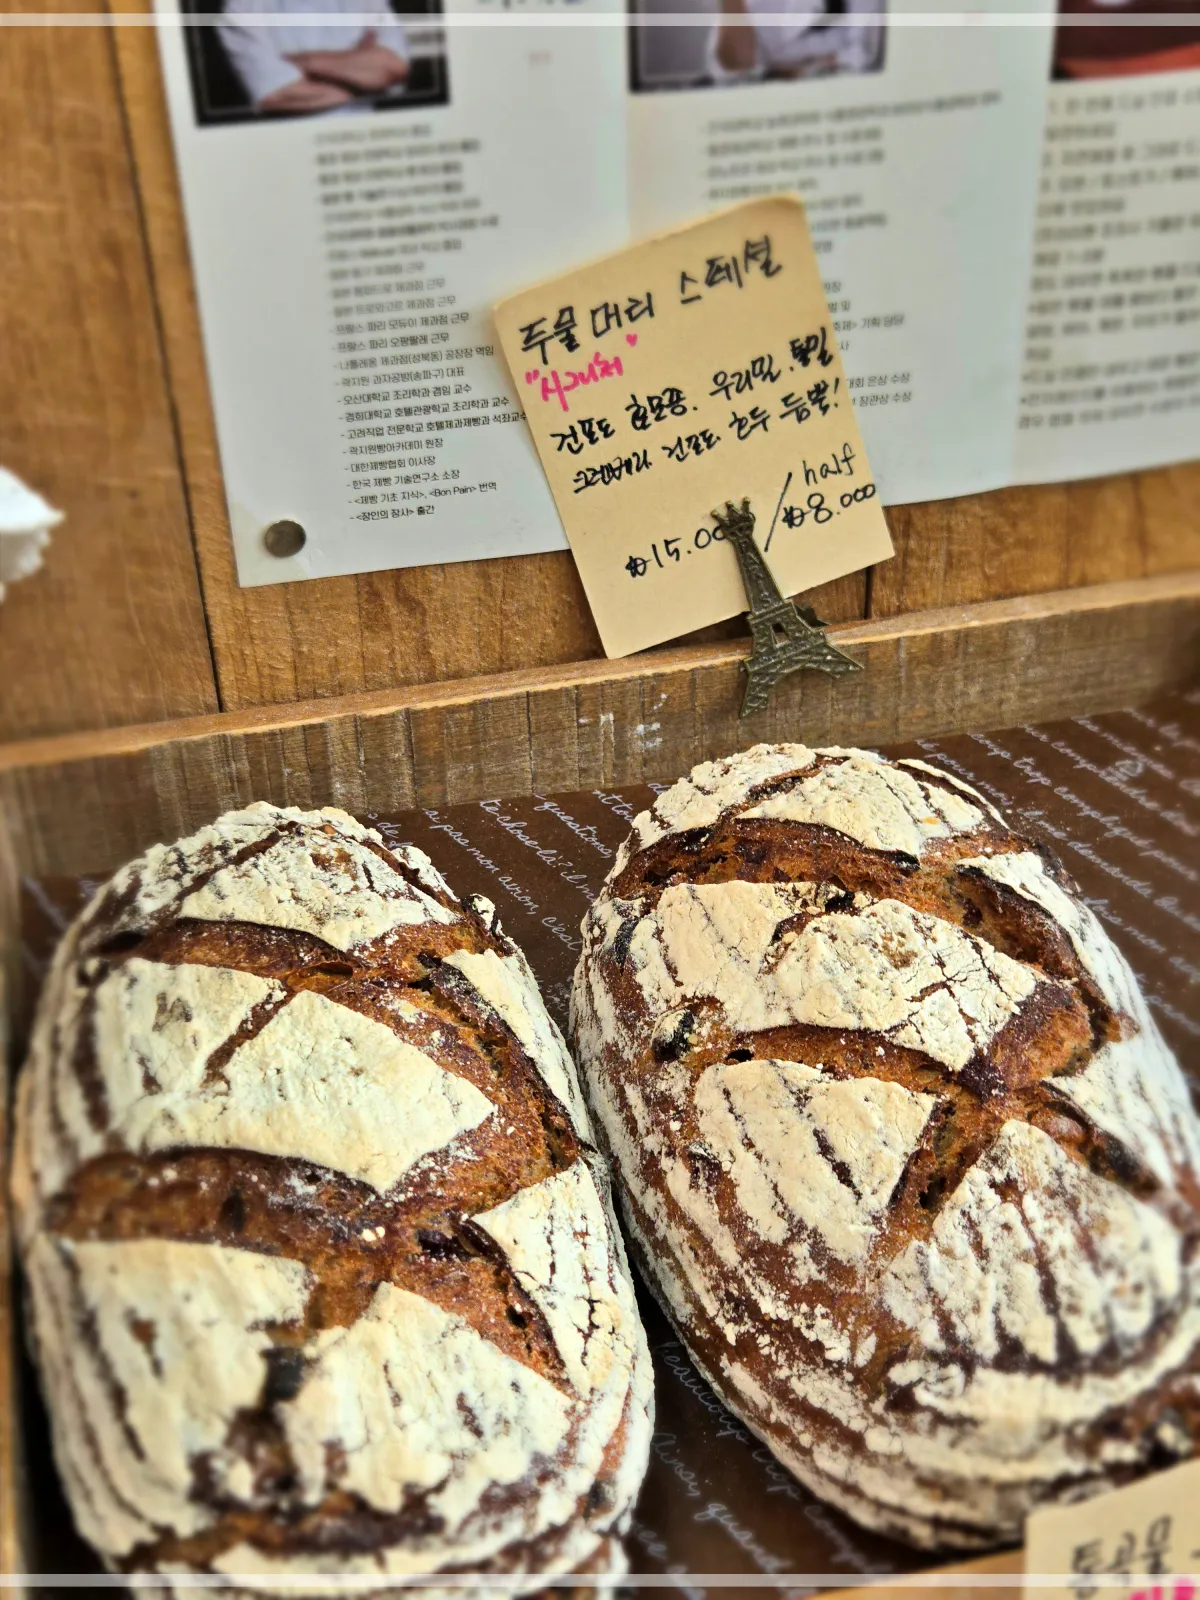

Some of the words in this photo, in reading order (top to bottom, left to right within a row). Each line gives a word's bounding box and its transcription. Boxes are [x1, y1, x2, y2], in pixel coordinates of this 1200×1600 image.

[437, 295, 456, 306] 근무
[336, 322, 364, 335] 프랑스
[367, 319, 386, 332] 파리
[420, 314, 448, 327] 제과점
[450, 312, 469, 324] 근무
[337, 341, 366, 354] 프랑스
[369, 338, 387, 350] 파리
[431, 332, 449, 344] 근무
[339, 357, 377, 371] 나폴레옹
[381, 350, 443, 367] 제과점(성북동)
[446, 347, 473, 361] 공장장
[475, 345, 494, 357] 역임
[373, 368, 444, 385] 과자공방(송파구)
[447, 366, 465, 377] 대표
[891, 372, 911, 385] 수상
[343, 393, 390, 405] 오산대학교
[393, 387, 430, 400] 조리학과
[432, 385, 451, 397] 겸임
[453, 383, 472, 394] 교수
[892, 391, 912, 403] 수상
[345, 409, 392, 422] 경희대학교
[394, 402, 450, 418] 호텔관광학교
[452, 398, 490, 411] 조리학과
[492, 396, 510, 407] 교수
[347, 426, 384, 439] 고려직업
[387, 422, 424, 436] 전문학교
[426, 415, 490, 432] 호텔제과제빵과
[349, 439, 423, 455] 곽지원빵아카데미
[425, 437, 444, 450] 원장
[350, 459, 406, 473] 대한제빵협회
[408, 455, 436, 467] 이사장
[802, 442, 856, 486] half
[352, 478, 371, 490] 한국
[373, 476, 392, 488] 제빵
[394, 471, 439, 486] 기술연구소
[442, 469, 460, 481] 소장
[381, 491, 399, 503] 기초
[429, 486, 452, 498] <Bon
[453, 484, 477, 496] Pain>
[479, 481, 498, 493] 번역
[356, 510, 389, 522] <장인의
[391, 507, 414, 519] 장사>
[417, 504, 435, 516] 출간
[466, 847, 500, 873] mon
